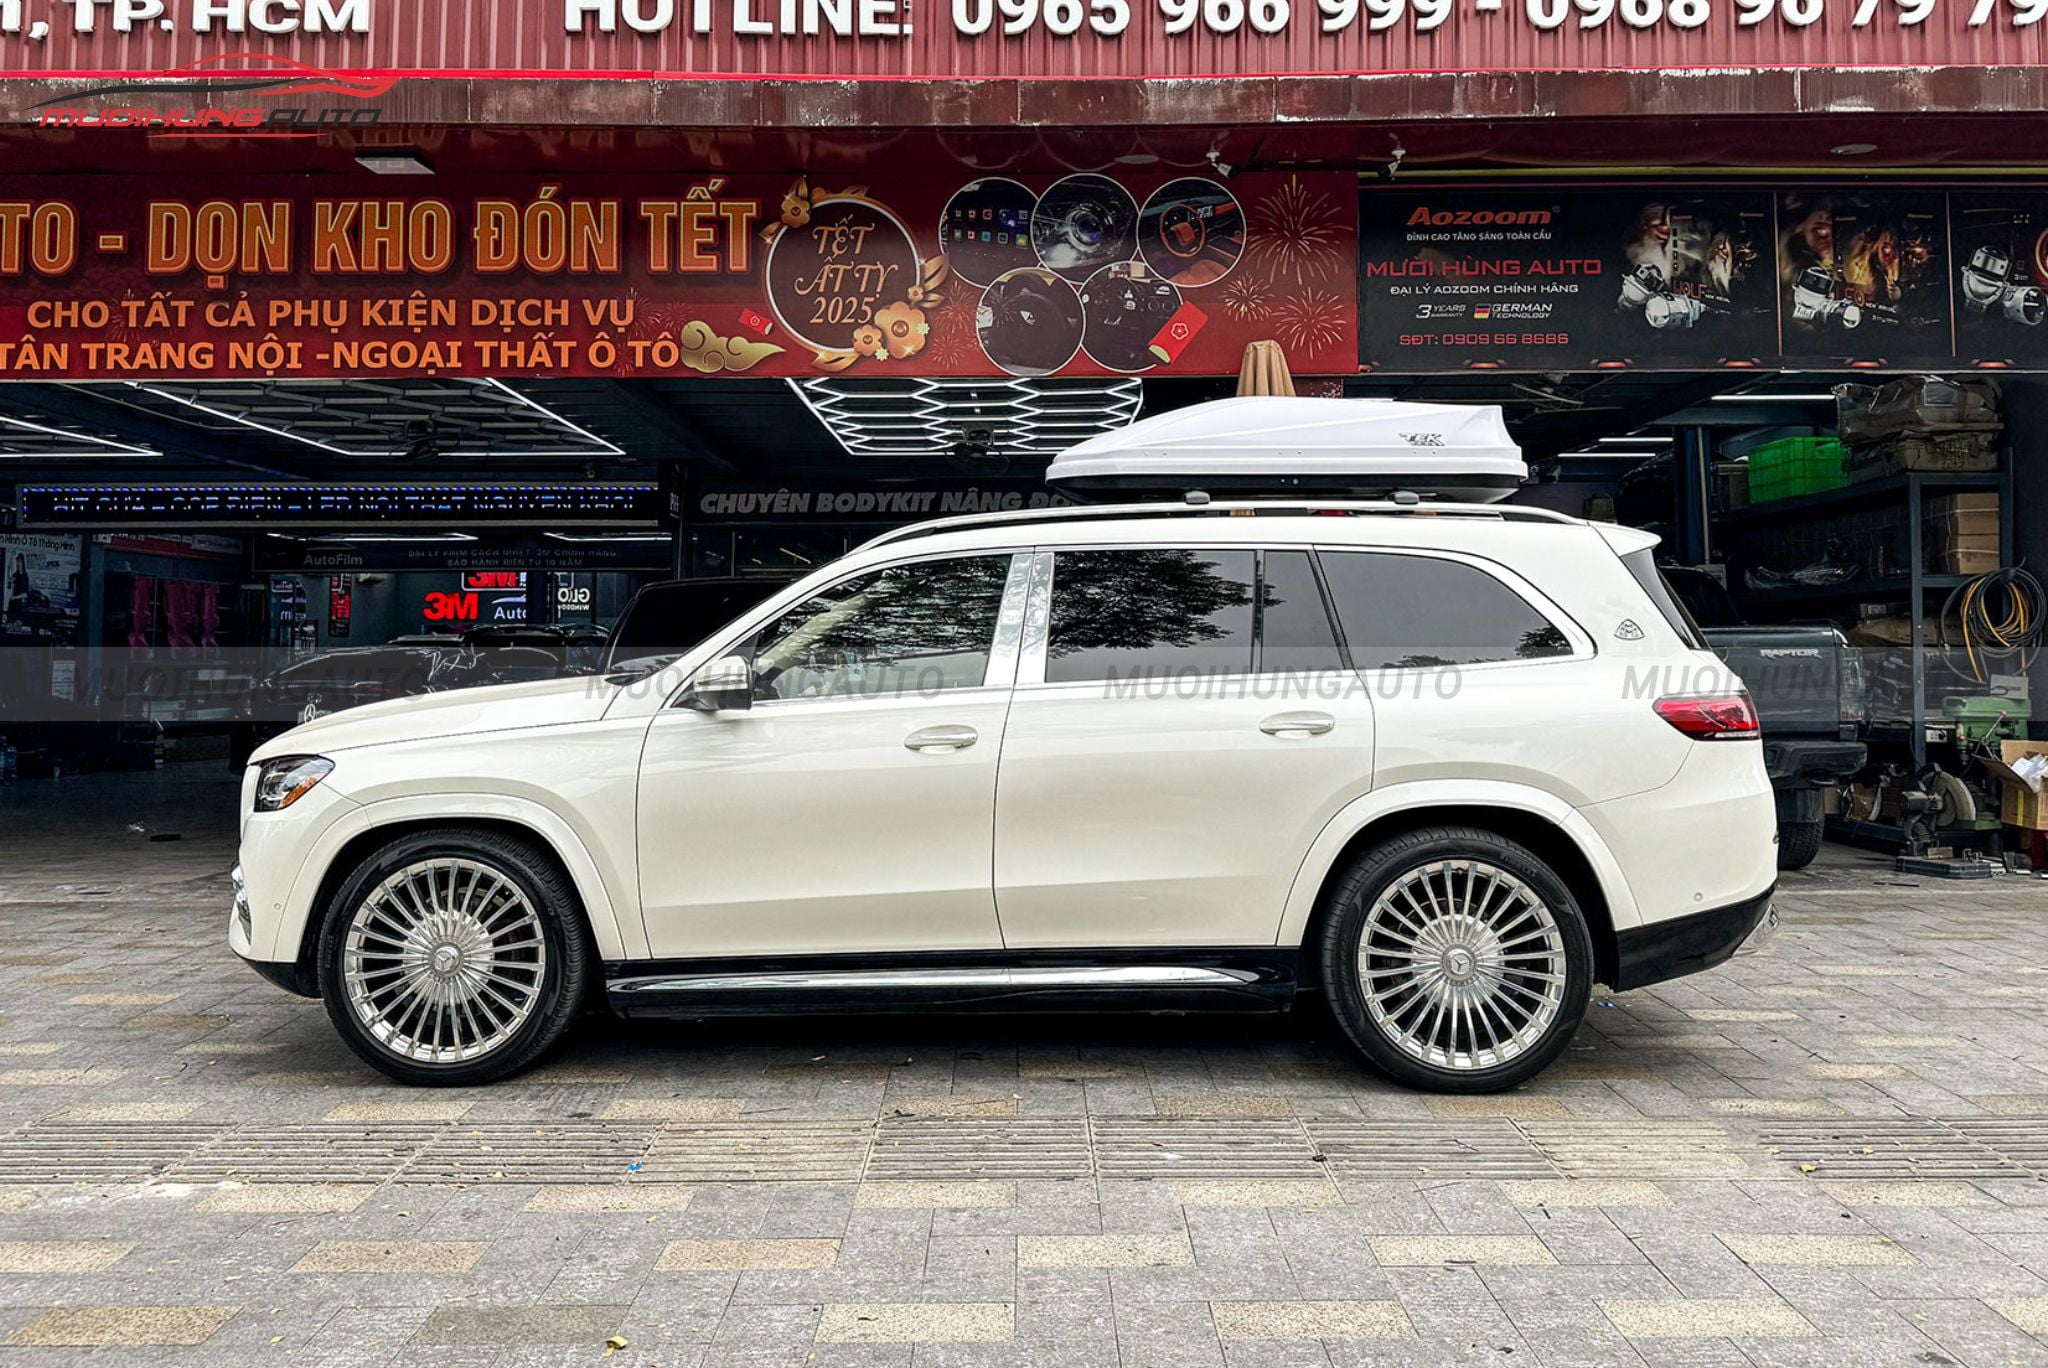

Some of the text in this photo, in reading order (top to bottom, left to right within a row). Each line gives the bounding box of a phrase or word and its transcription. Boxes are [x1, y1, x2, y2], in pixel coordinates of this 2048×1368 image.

[62, 0, 173, 32] TP.
[193, 0, 369, 33] HCM
[565, 0, 913, 36] HOTLINE:
[952, 0, 1130, 35] 0965
[1162, 0, 1290, 33] 966
[1318, 0, 1451, 31] 999
[1525, 0, 1711, 29] 0968
[1735, 0, 1823, 27] 90
[148, 202, 290, 289] DỌN
[314, 202, 451, 272] KHO
[474, 187, 621, 272] ĐÓN
[641, 178, 757, 272] TẾT
[812, 214, 875, 259] TẾT
[1431, 233, 1450, 241] CAO
[1441, 256, 1521, 276] HÙNG
[1526, 259, 1602, 275] AUTO
[1390, 285, 1412, 297] ĐẠI
[1415, 283, 1431, 294] LÝ
[1433, 285, 1490, 294] AOZOOM
[1493, 282, 1537, 293] CHÍNH
[27, 290, 634, 333] CHO TẤT CẢ PHỤ KIỆN DỊCH VỤ
[810, 296, 874, 324] 2025
[1415, 304, 1466, 318] 3 YEARS
[1492, 303, 1552, 312] GERMAN
[1442, 333, 1490, 344] 0909
[1494, 333, 1517, 344] 66
[81, 342, 214, 370] TRANG
[229, 333, 302, 376] NỘI
[475, 332, 576, 369] THẤT
[588, 332, 616, 369] Ô
[627, 332, 679, 369] TÔ
[699, 488, 810, 513] CHUYÊN
[816, 491, 936, 513] BODYKIT
[939, 487, 1022, 512] NÂNG
[424, 592, 479, 620] 3M
[1760, 648, 1823, 660] RAPTOR
